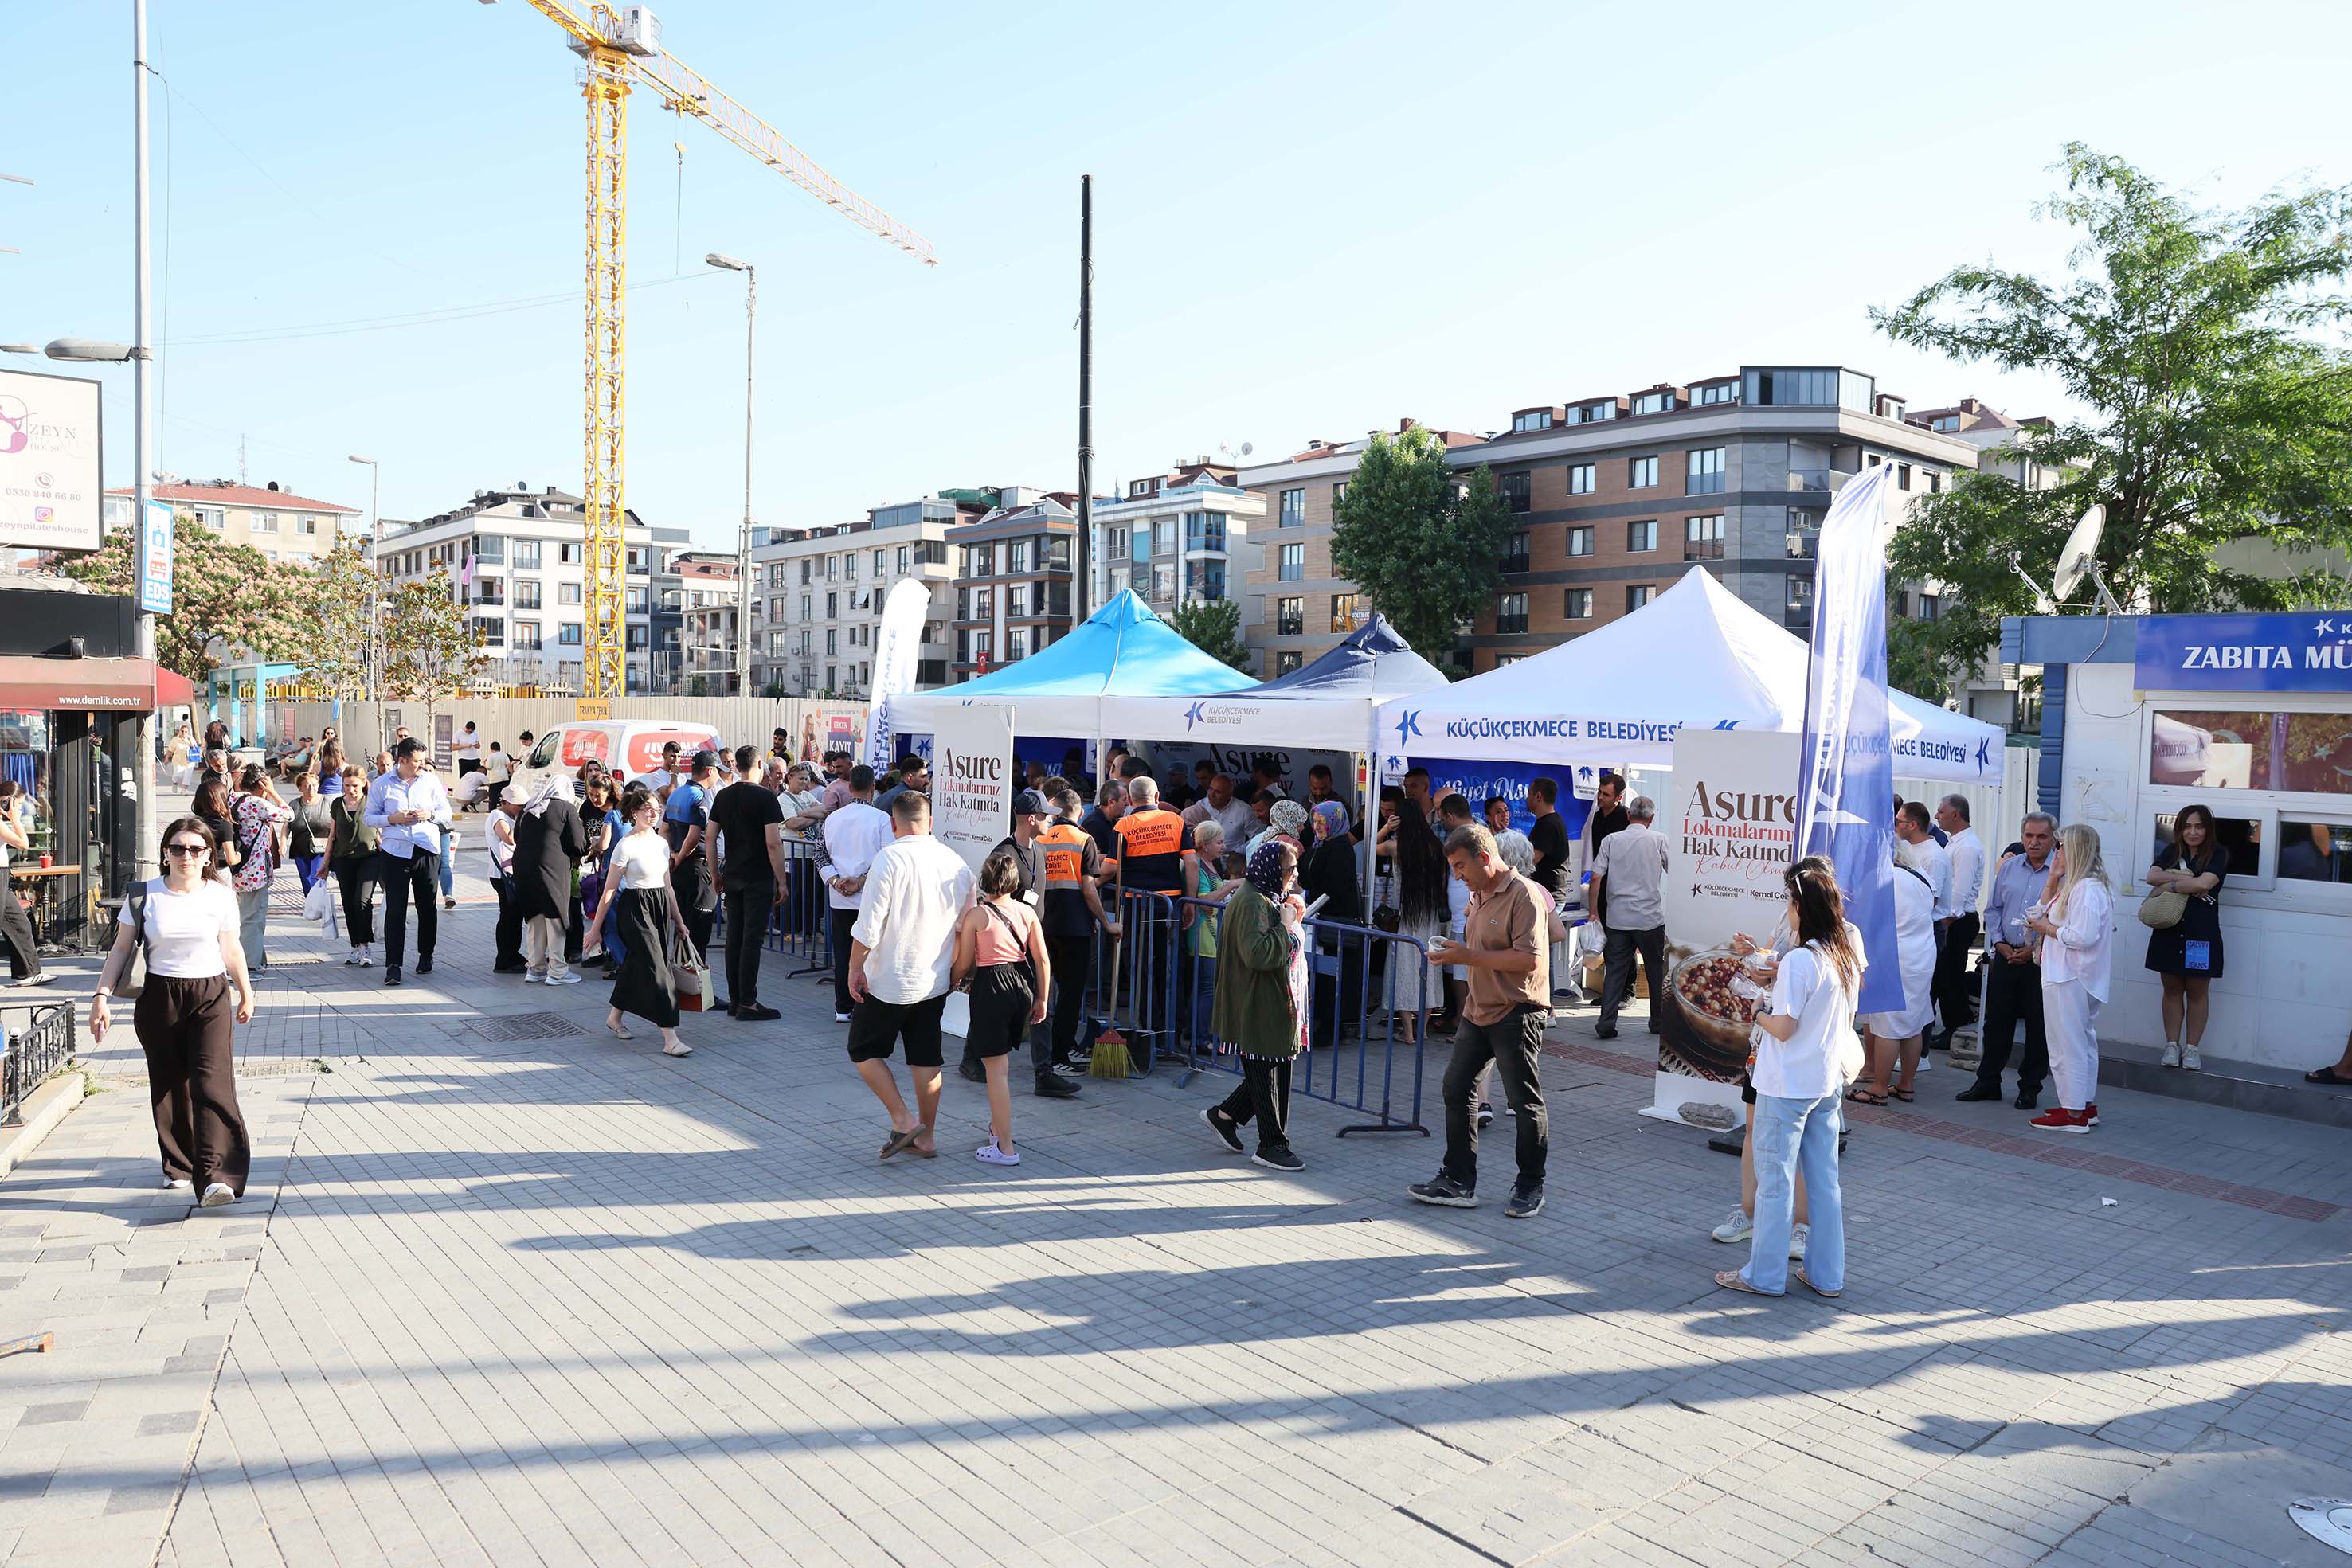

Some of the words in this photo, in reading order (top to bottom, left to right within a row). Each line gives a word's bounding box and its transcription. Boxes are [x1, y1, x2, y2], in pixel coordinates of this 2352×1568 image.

[29, 424, 76, 439] ZEYN
[6, 487, 30, 497] 0530
[33, 490, 52, 499] 840
[69, 493, 82, 502] 80
[146, 581, 170, 602] EDS
[2182, 646, 2293, 669] ZABITA
[58, 695, 141, 706] www.demlik.com.tr
[1208, 704, 1262, 715] KÜÇÜKÇEKMECE
[1207, 715, 1243, 725] BELEDİYESİ
[1446, 718, 1578, 740] KÜÇÜKÇEKMECE
[1587, 721, 1683, 742] BELEDİYES
[829, 740, 851, 753] KAYIT
[1920, 741, 1967, 764] BELEDİYESİ
[941, 747, 1001, 780] Aşure
[939, 777, 1001, 796] Lokmalarımız
[939, 792, 957, 808] Hak
[961, 795, 1000, 813] Katında
[1684, 781, 1797, 824] Aşure
[1127, 823, 1173, 836] KÜÇÜKÇEKMECE
[1135, 831, 1167, 841] BELEDİYESİ
[1682, 836, 1720, 857] Hak
[1726, 840, 1792, 863] Katınd
[1695, 853, 1743, 875] Kabul
[1704, 884, 1745, 893] KÜÇÜKÇEKMECE
[1750, 889, 1773, 899] Kemal
[1774, 891, 1789, 900] Çeb
